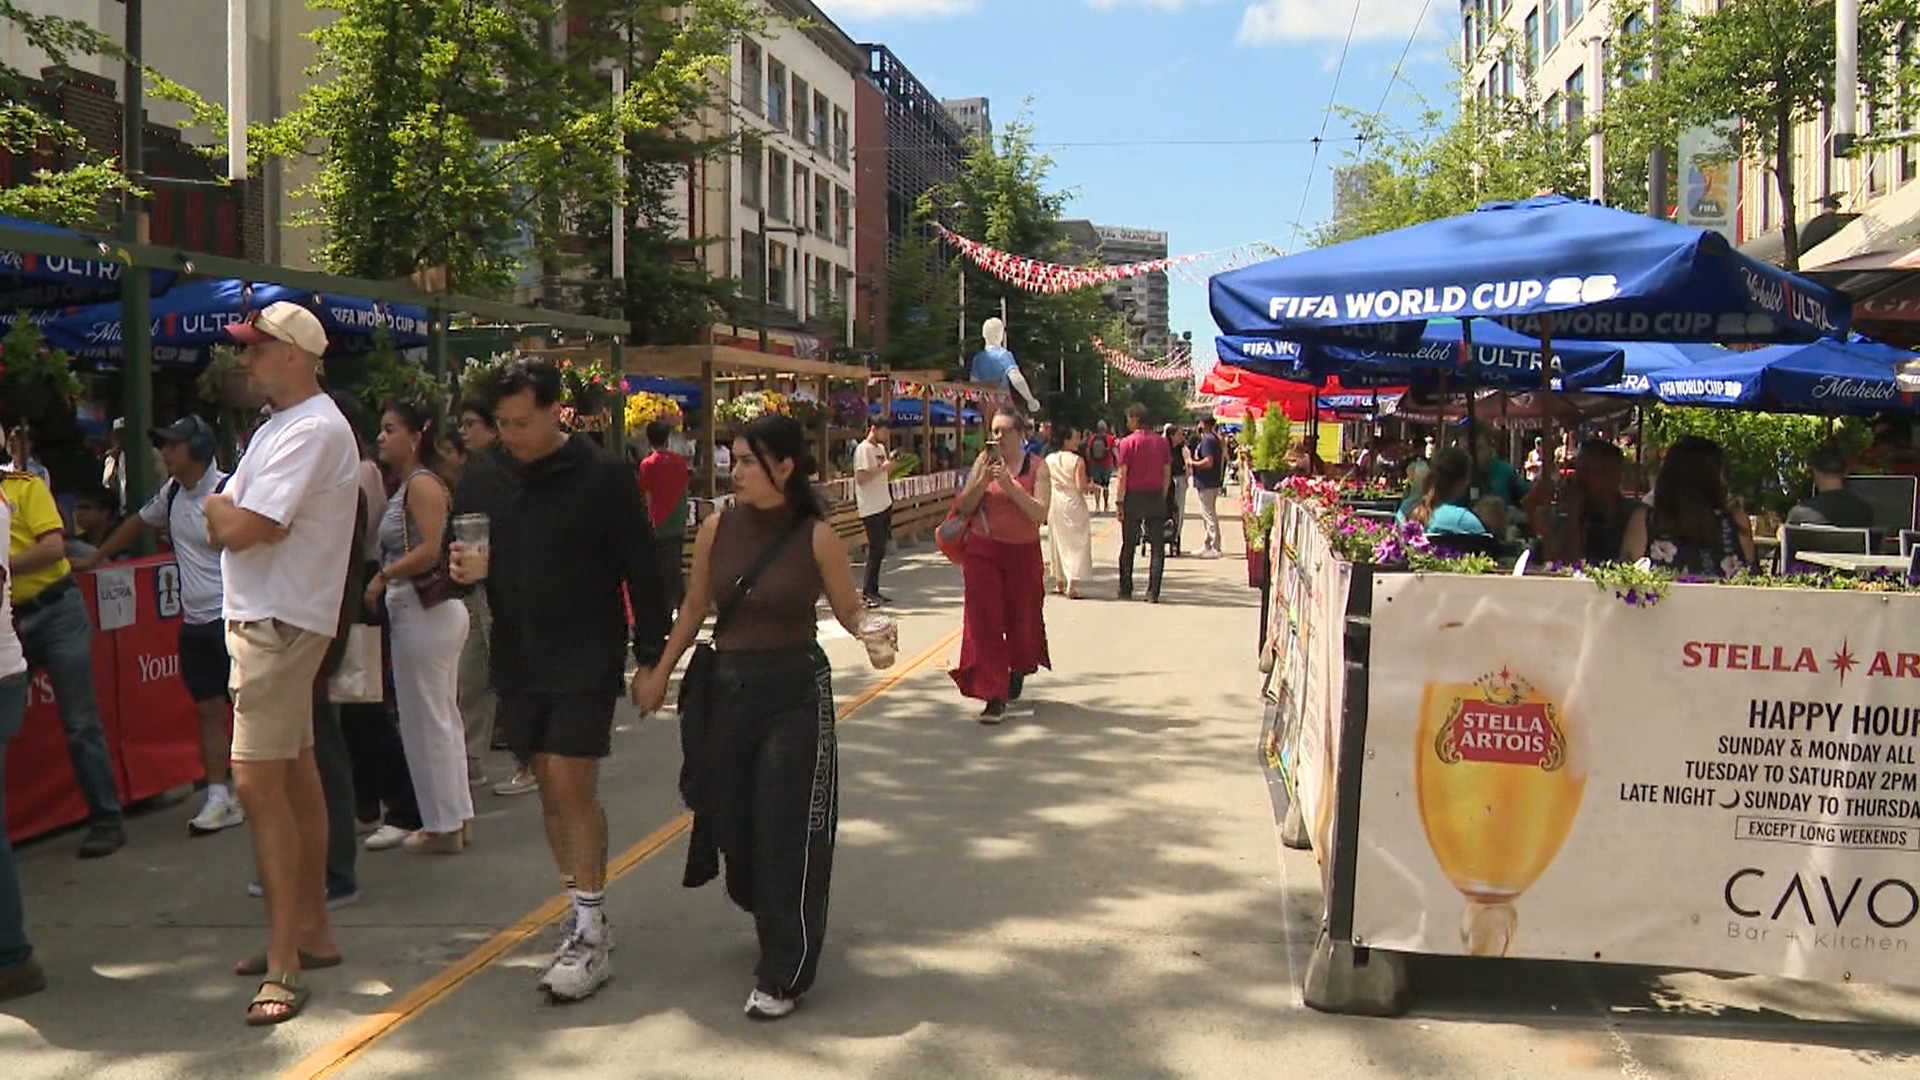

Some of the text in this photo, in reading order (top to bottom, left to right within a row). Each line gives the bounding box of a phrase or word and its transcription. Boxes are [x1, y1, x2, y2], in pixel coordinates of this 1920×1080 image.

[1269, 294, 1338, 320] FIFA
[1345, 284, 1470, 318] WORLD
[1472, 280, 1542, 310] CUP
[1792, 291, 1839, 331] ULTRA
[395, 317, 415, 331] CUP
[1550, 311, 1650, 335] WORLD
[1654, 312, 1712, 335] CUP
[1243, 341, 1275, 357] FIFA
[1478, 346, 1564, 373] ULTRA
[1675, 379, 1706, 395] WORLD
[1705, 380, 1724, 394] CUP
[1812, 375, 1898, 400] Michelob
[101, 589, 133, 601] ULTRA
[1683, 641, 1821, 673] STELLA
[1463, 712, 1544, 733] STELLA
[1749, 699, 1843, 732] HAPPY
[1460, 732, 1546, 753] ARTOIS
[1718, 735, 1915, 765] SUNDAY & MONDAY ALL
[1685, 760, 1917, 792] TUESDAY TO SATURDAY 2PM
[1620, 783, 1658, 803] LATE
[1663, 785, 1717, 807] NIGHT
[1744, 791, 1812, 814] SUNDAY
[1818, 795, 1839, 816] TO
[1749, 821, 1908, 846] EXCEPT LONG WEEKENDS
[1725, 867, 1920, 929] CAVO
[1728, 921, 1769, 942] Bar
[1814, 933, 1908, 951] Kitchen
